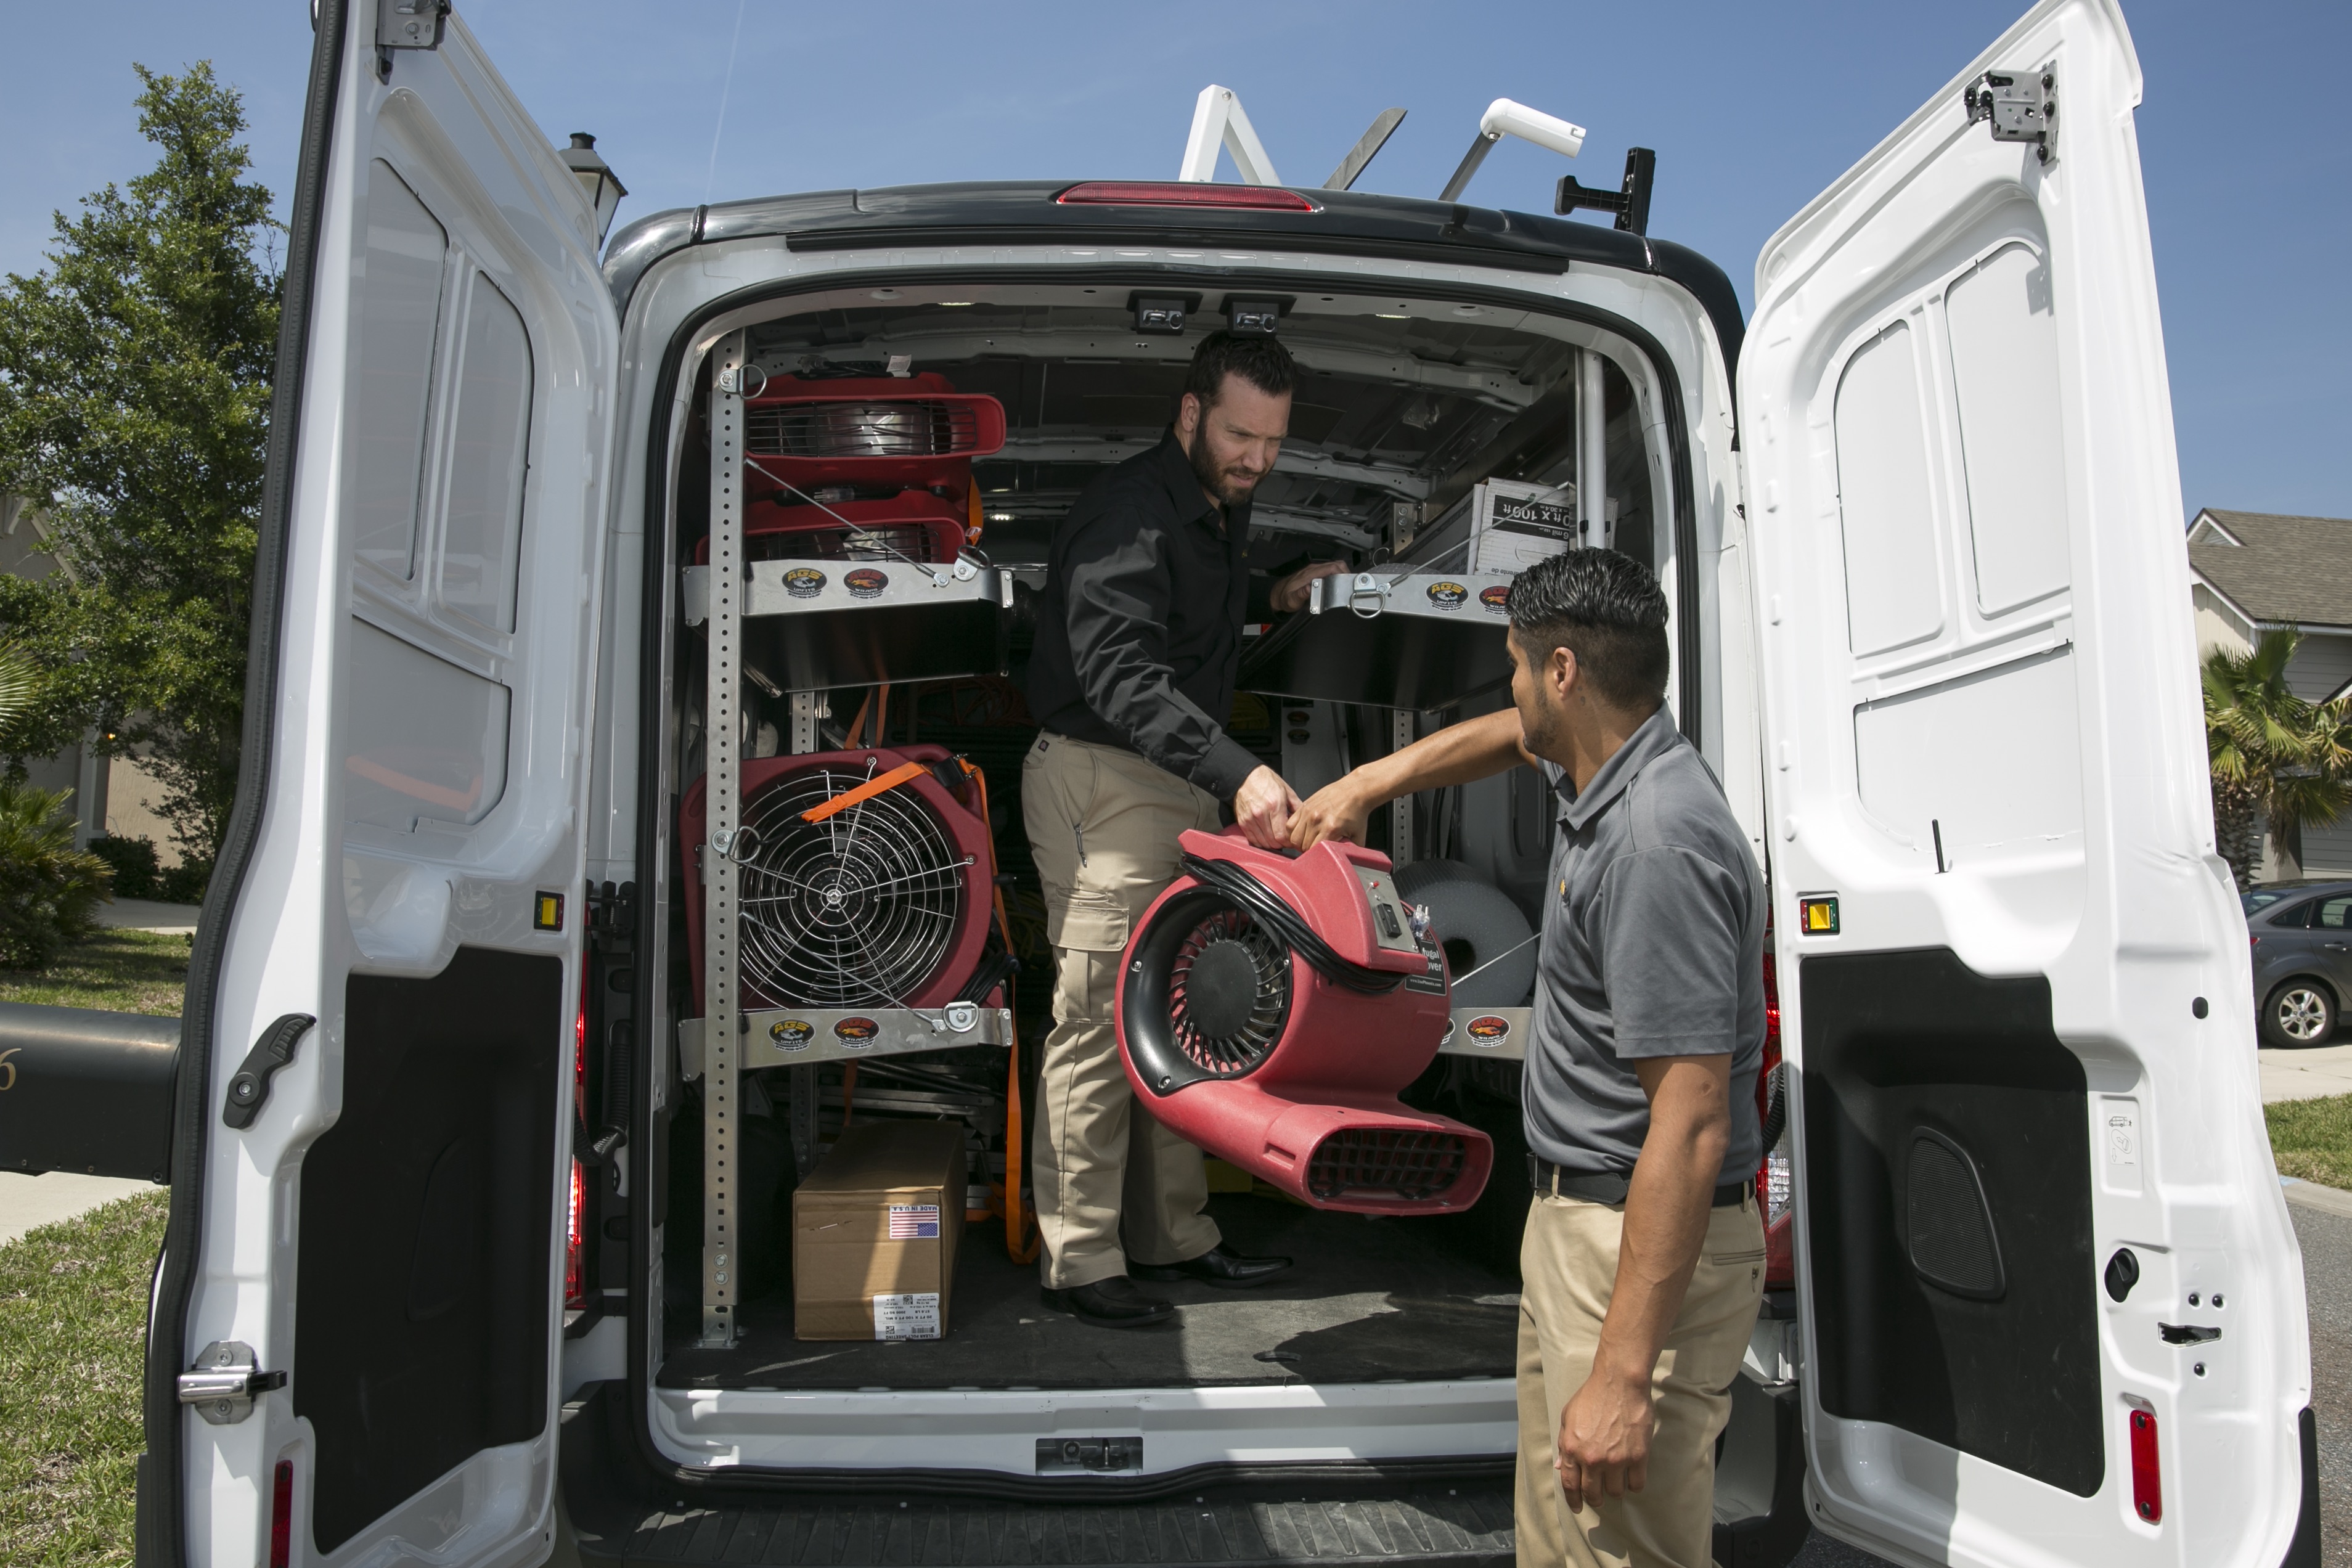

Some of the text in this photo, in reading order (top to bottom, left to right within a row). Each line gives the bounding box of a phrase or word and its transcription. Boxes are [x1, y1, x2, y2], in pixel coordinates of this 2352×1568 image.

[1503, 504, 1511, 513] ft
[1553, 513, 1561, 522] ft
[788, 570, 823, 582] AGS
[1432, 582, 1464, 594] AGS
[1410, 979, 1442, 987] www.UsePhoenix.com
[775, 1021, 810, 1034] AGS
[839, 1018, 875, 1032] AGS
[1472, 1018, 1505, 1031] AGS
